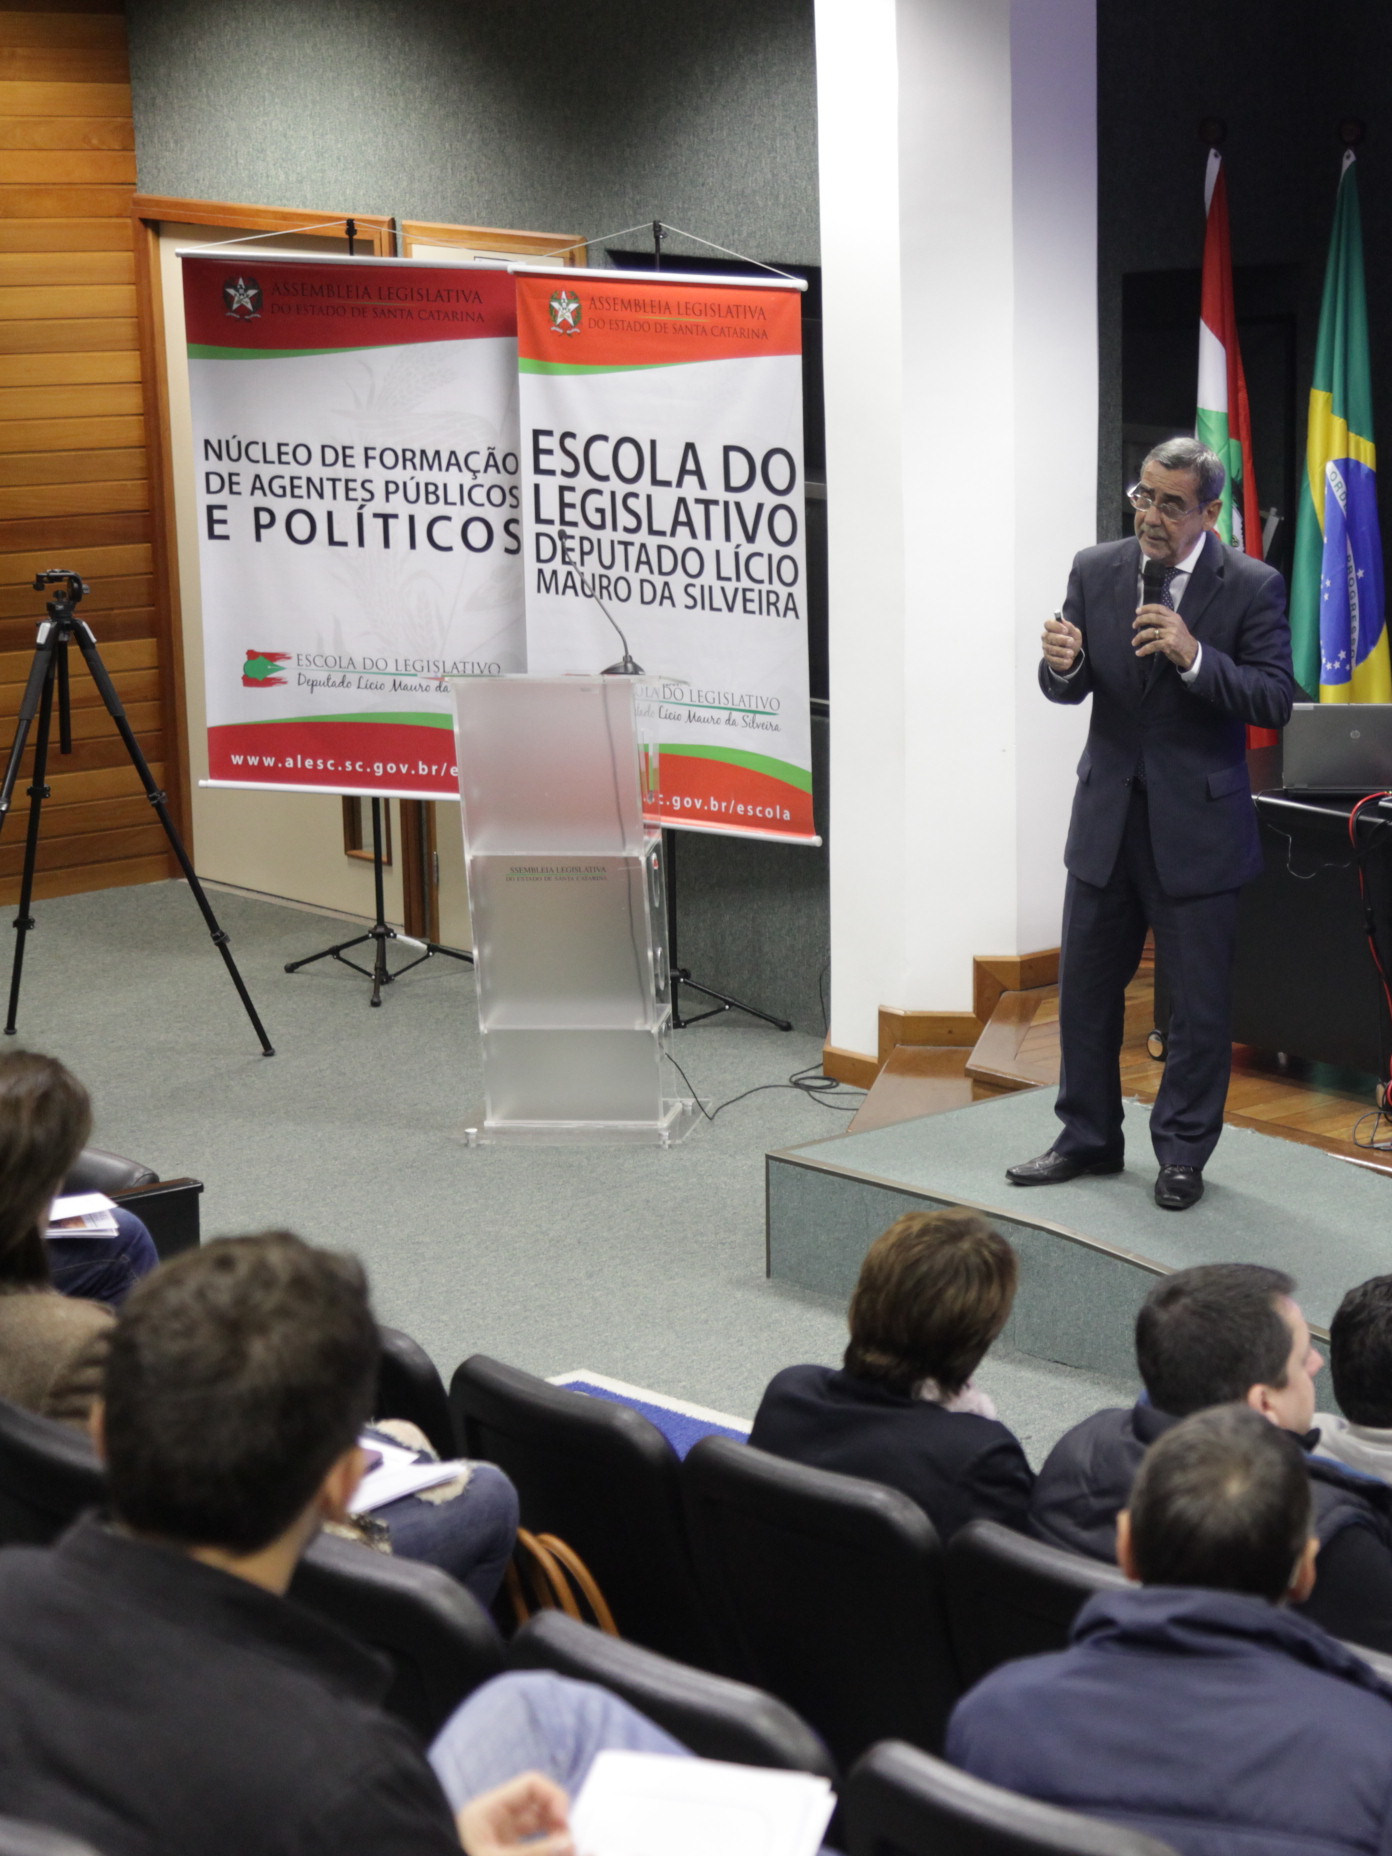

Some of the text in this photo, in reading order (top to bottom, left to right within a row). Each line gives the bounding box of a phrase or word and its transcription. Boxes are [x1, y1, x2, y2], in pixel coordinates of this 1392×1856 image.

[271, 282, 484, 304] ASSEMBLEIA LEGISLATIVA
[271, 303, 484, 323] DO ESTADO DE SANTA CATARINA
[589, 296, 767, 321] ASSEMBLEIA LEGISLATIVA
[589, 318, 768, 340] DO ESTADO DE SANTA CATARINA
[203, 435, 519, 480] NÚCLEO DE FORMAÇÃO
[532, 428, 797, 497] ESCOLA DO
[204, 471, 520, 509] DE AGENTES PÚBLICOS
[533, 483, 798, 548] LEGISLATIVO
[206, 504, 522, 556] E POLÍTICOS
[535, 531, 799, 588] DEPUTADO LÍCIO
[536, 568, 800, 620] MAURO DA SILVEIRA
[296, 653, 501, 675] ESCOLA DO LEGISLATIVO
[297, 673, 450, 694] Deputado Lício Mauro da
[662, 686, 684, 700] DO
[690, 690, 780, 711] LEGISLATIVO
[658, 705, 682, 721] Lício
[685, 709, 721, 726] Mauro
[725, 712, 738, 727] da
[742, 715, 781, 732] Silveira
